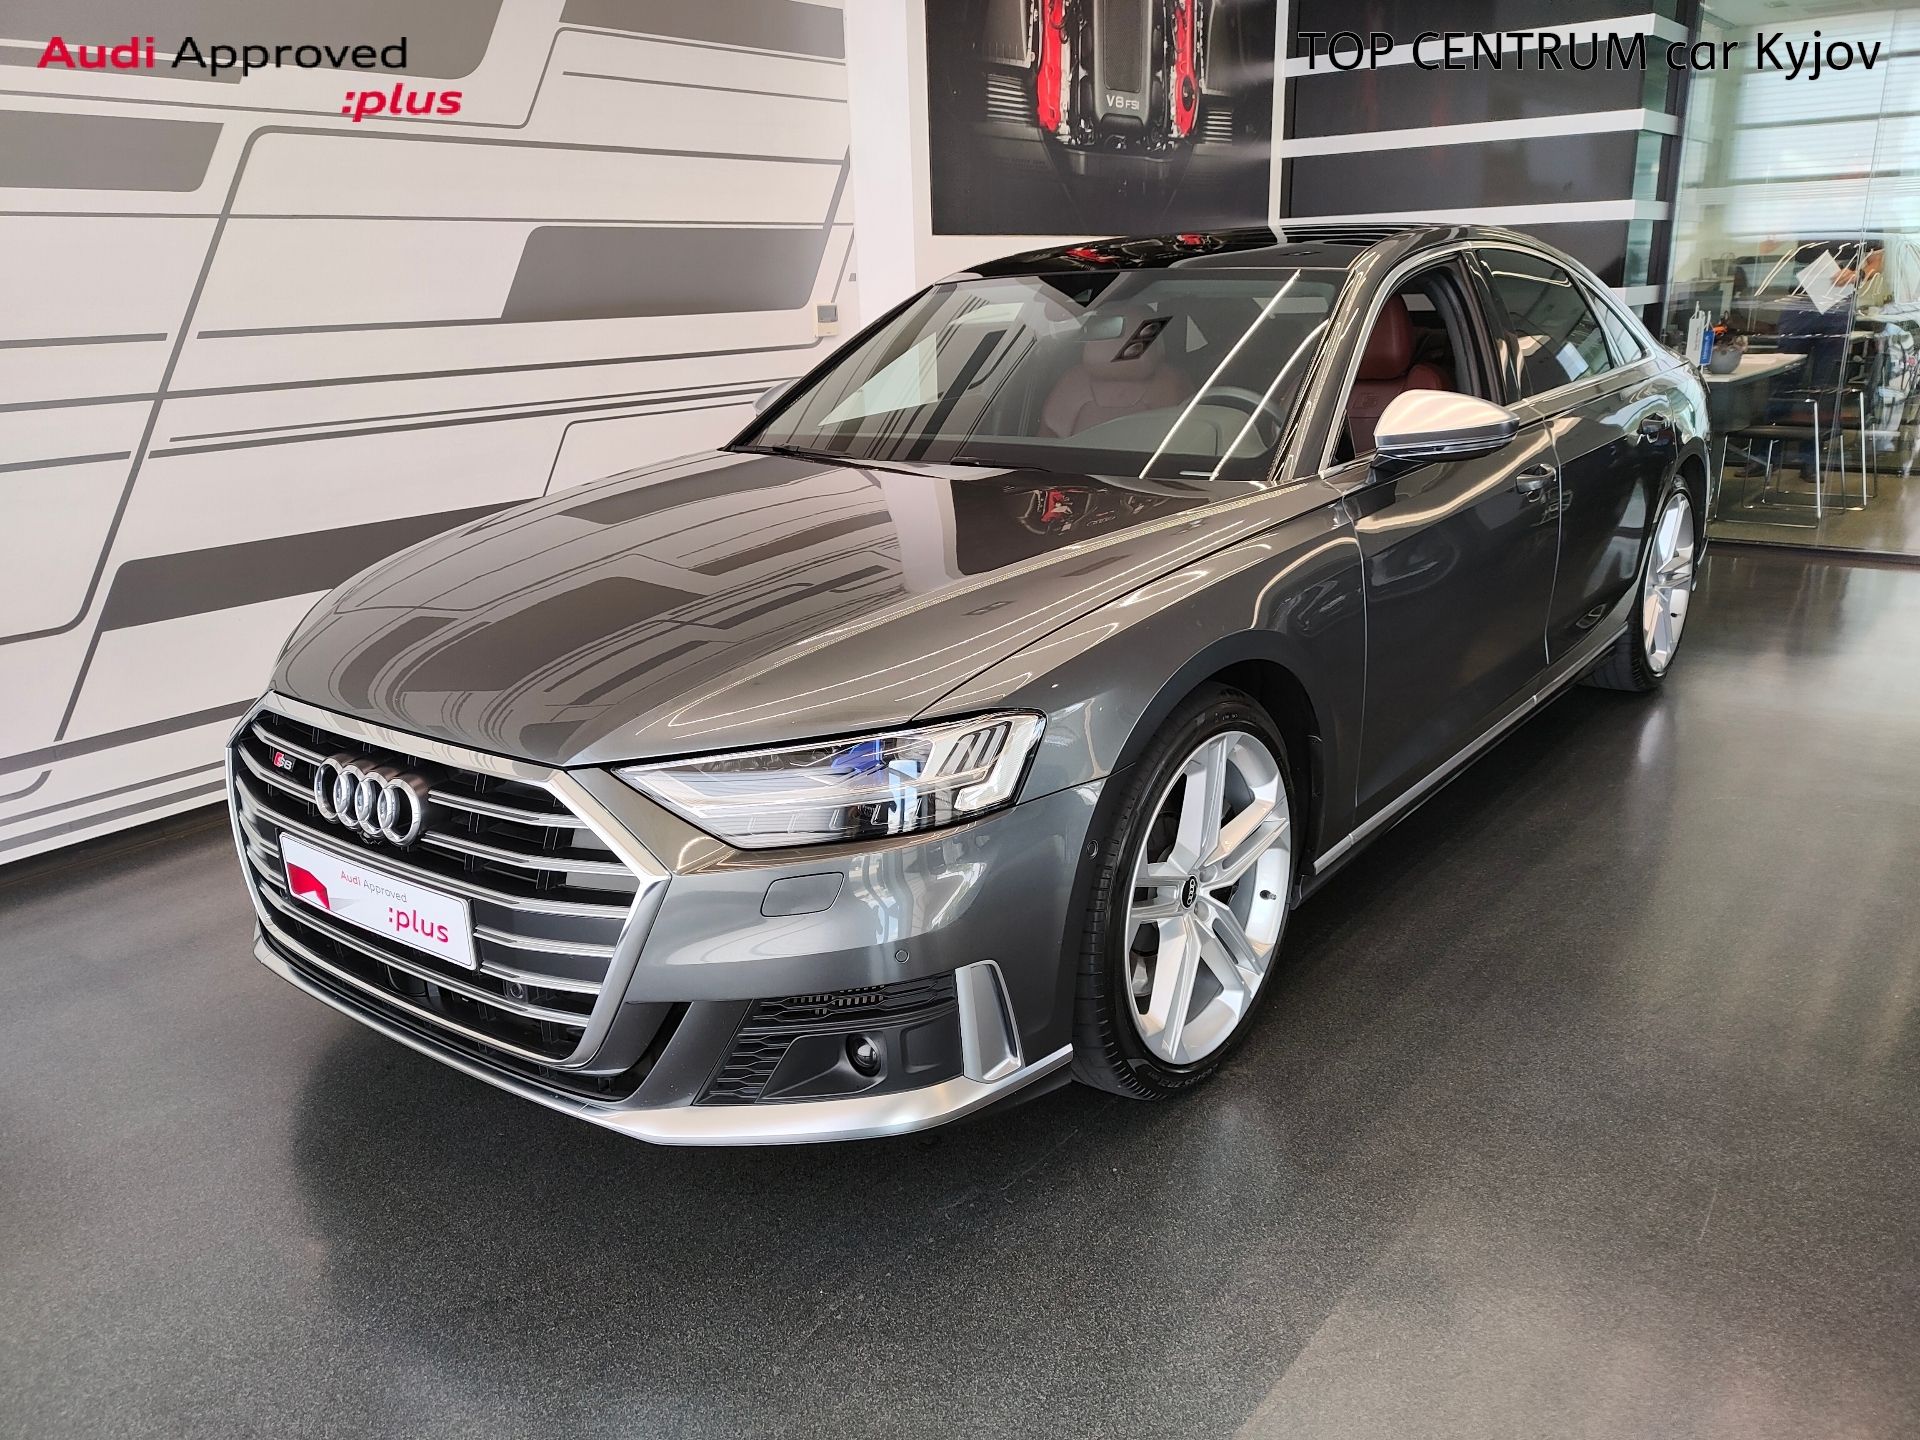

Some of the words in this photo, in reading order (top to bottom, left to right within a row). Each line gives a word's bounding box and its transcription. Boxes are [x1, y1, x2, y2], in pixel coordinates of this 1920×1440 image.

[1106, 94, 1124, 108] V8
[340, 870, 361, 886] Audi
[363, 879, 408, 903] Approved
